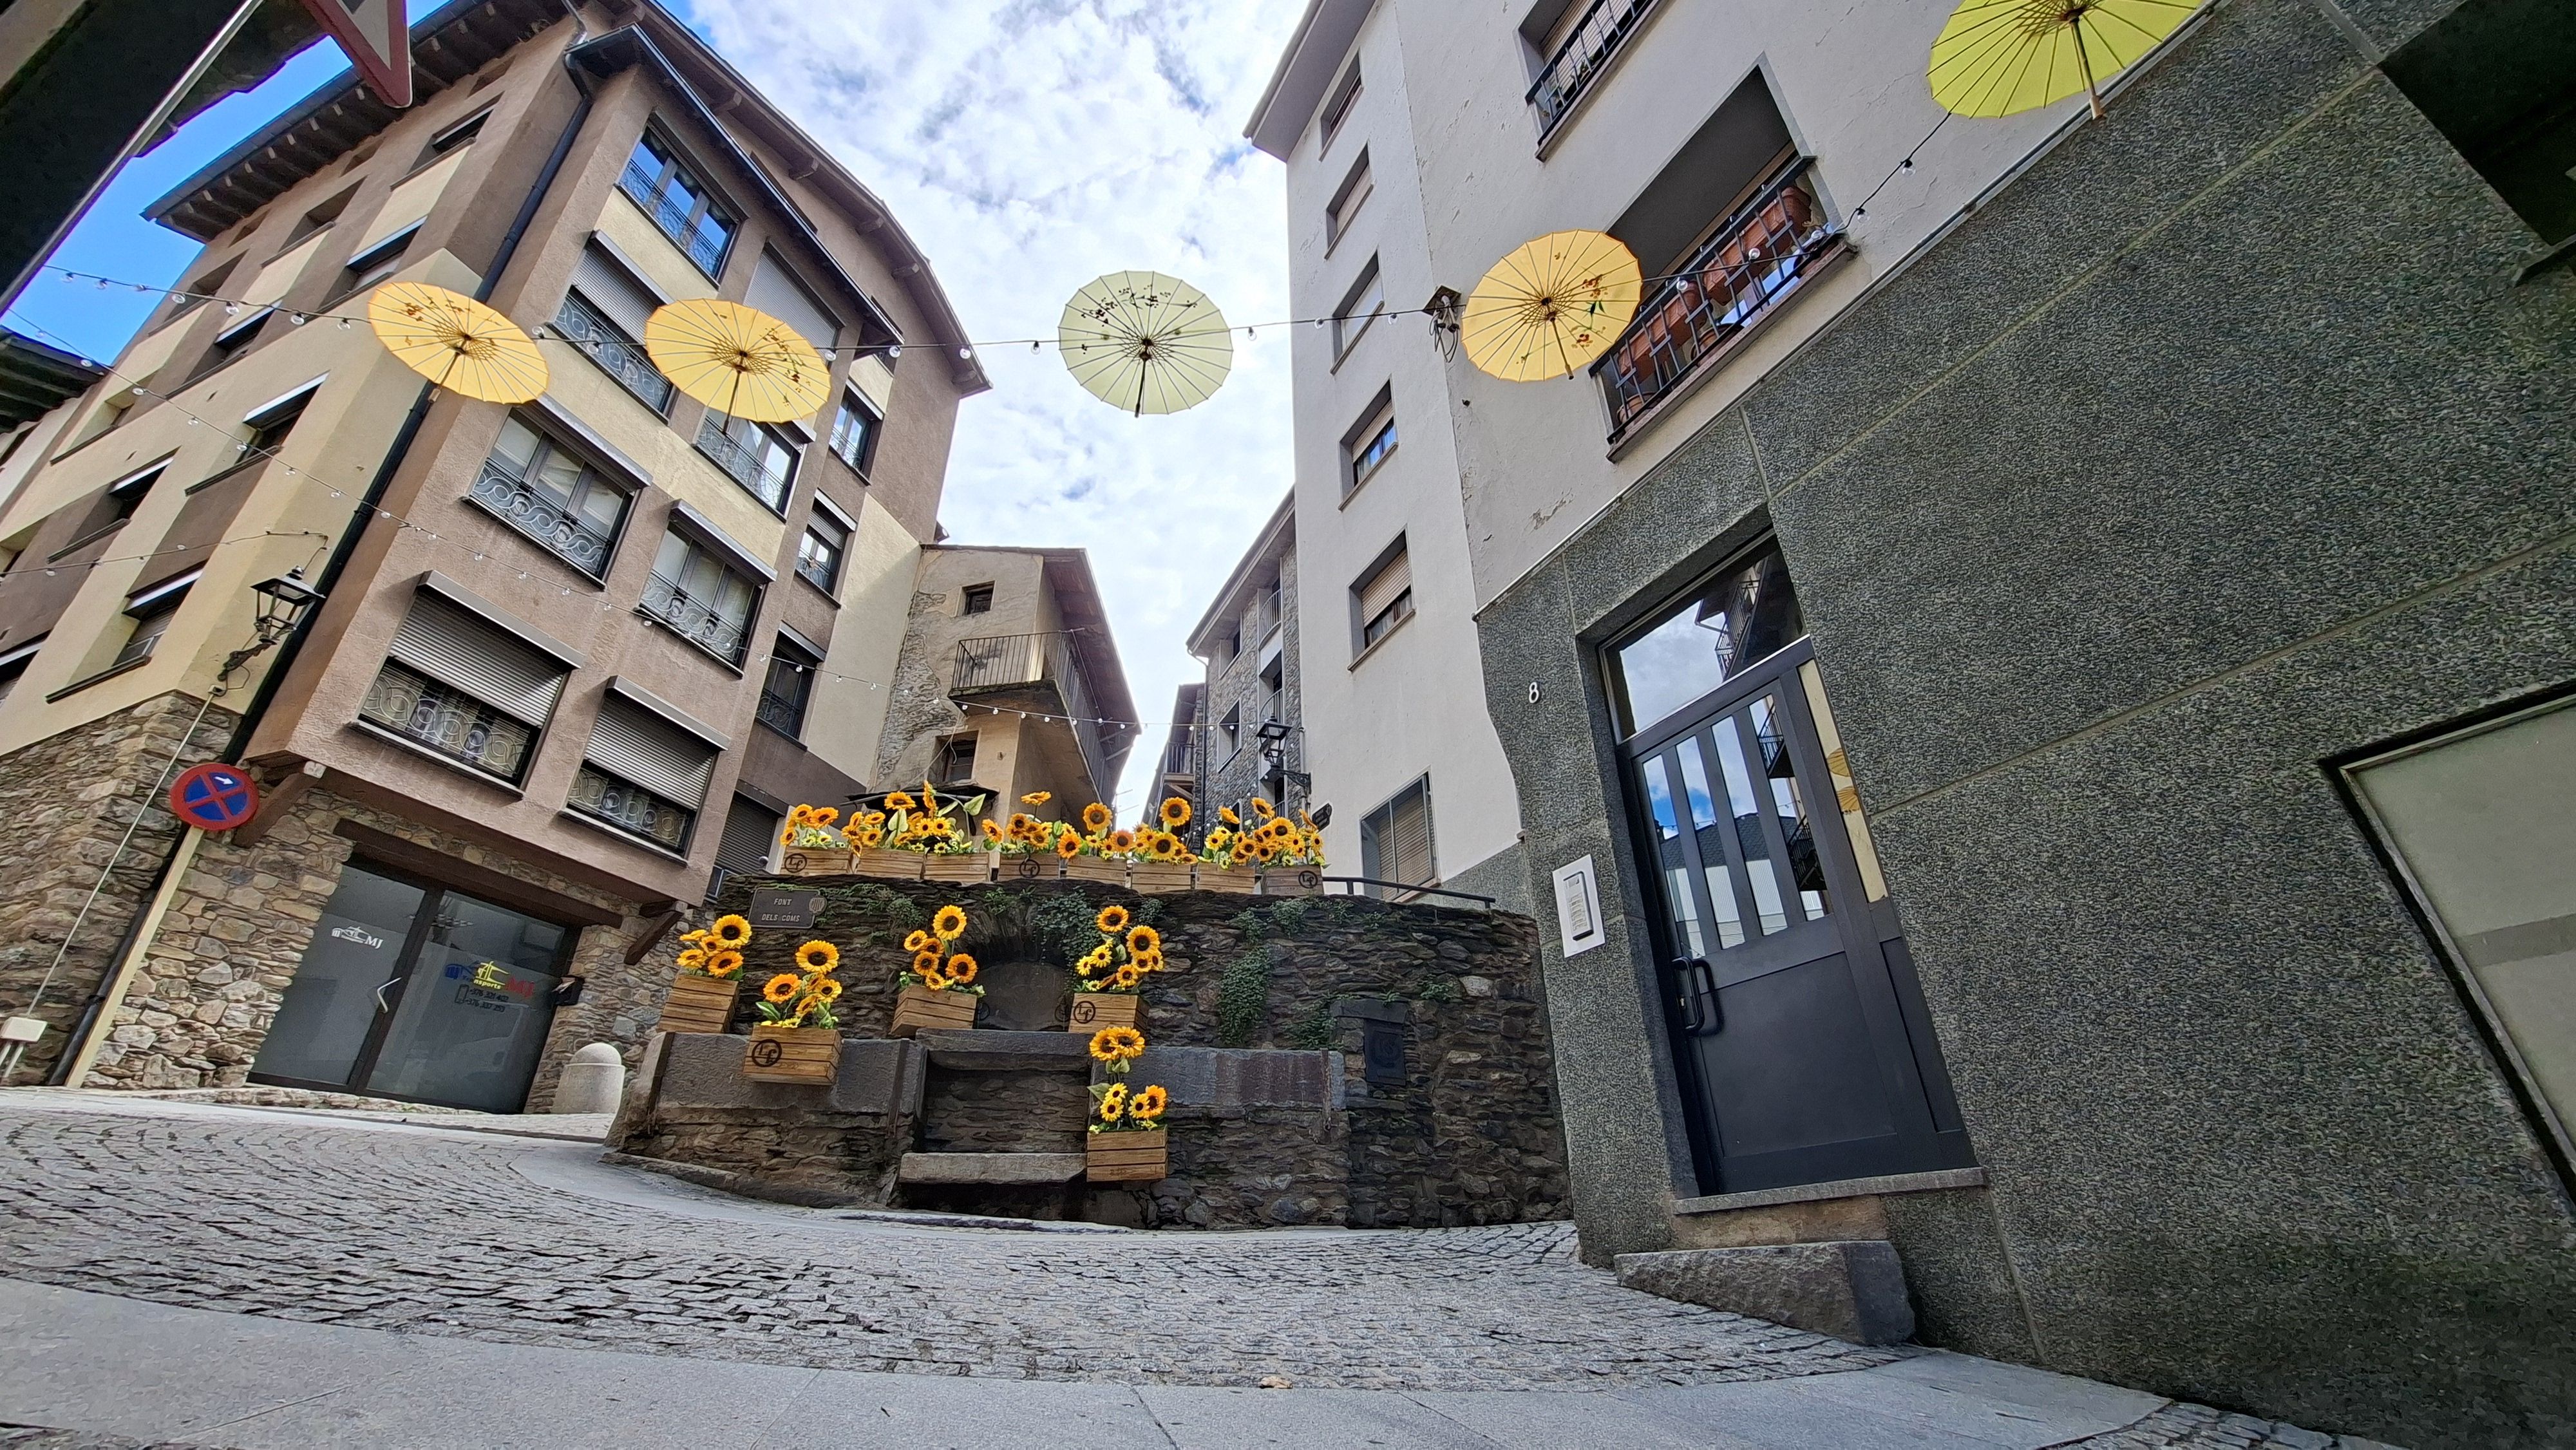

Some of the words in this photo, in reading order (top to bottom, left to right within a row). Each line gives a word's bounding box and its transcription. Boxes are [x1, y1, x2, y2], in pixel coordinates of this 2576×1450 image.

[1529, 682, 1539, 703] 8
[781, 912, 800, 922] CÓMS
[365, 936, 383, 949] MJ
